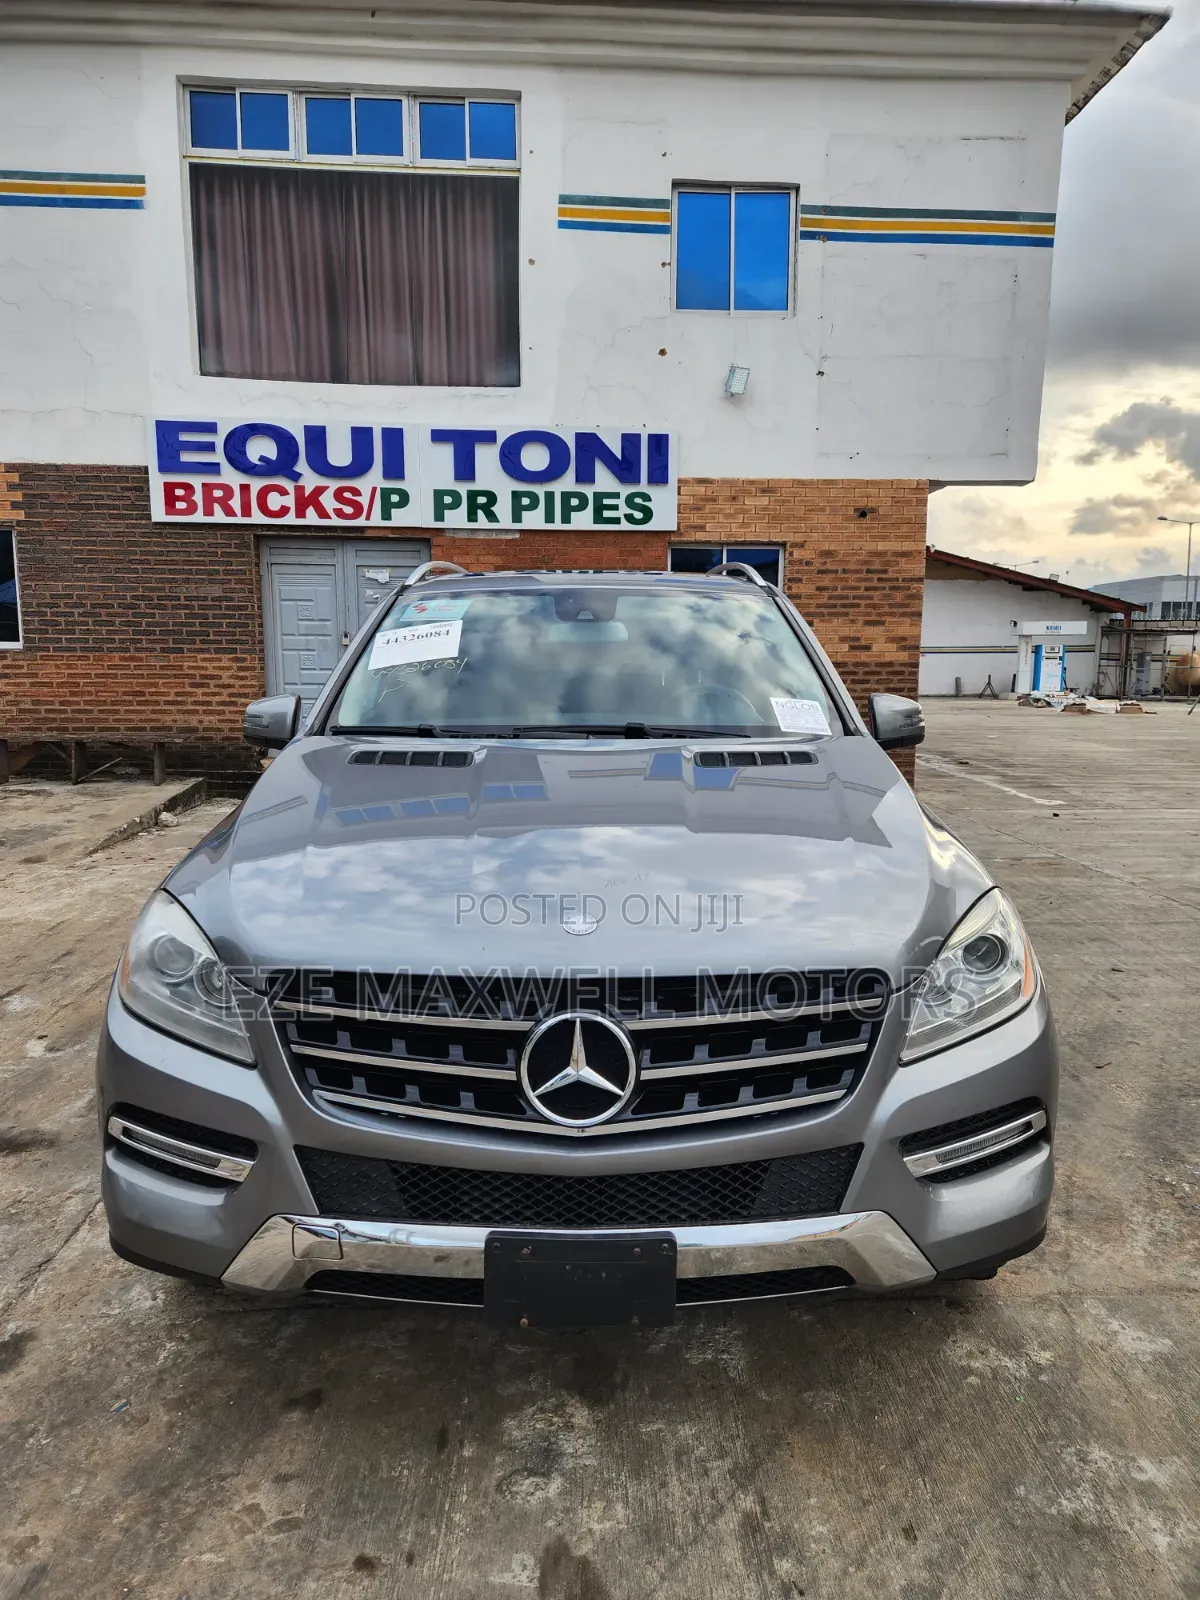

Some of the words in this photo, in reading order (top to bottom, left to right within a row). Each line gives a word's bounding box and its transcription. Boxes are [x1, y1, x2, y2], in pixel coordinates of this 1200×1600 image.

[155, 420, 405, 482] EQUI
[430, 429, 669, 485] TONI
[511, 490, 654, 525] PIPES
[382, 629, 450, 645] 44326084
[775, 700, 820, 711] NGLOS
